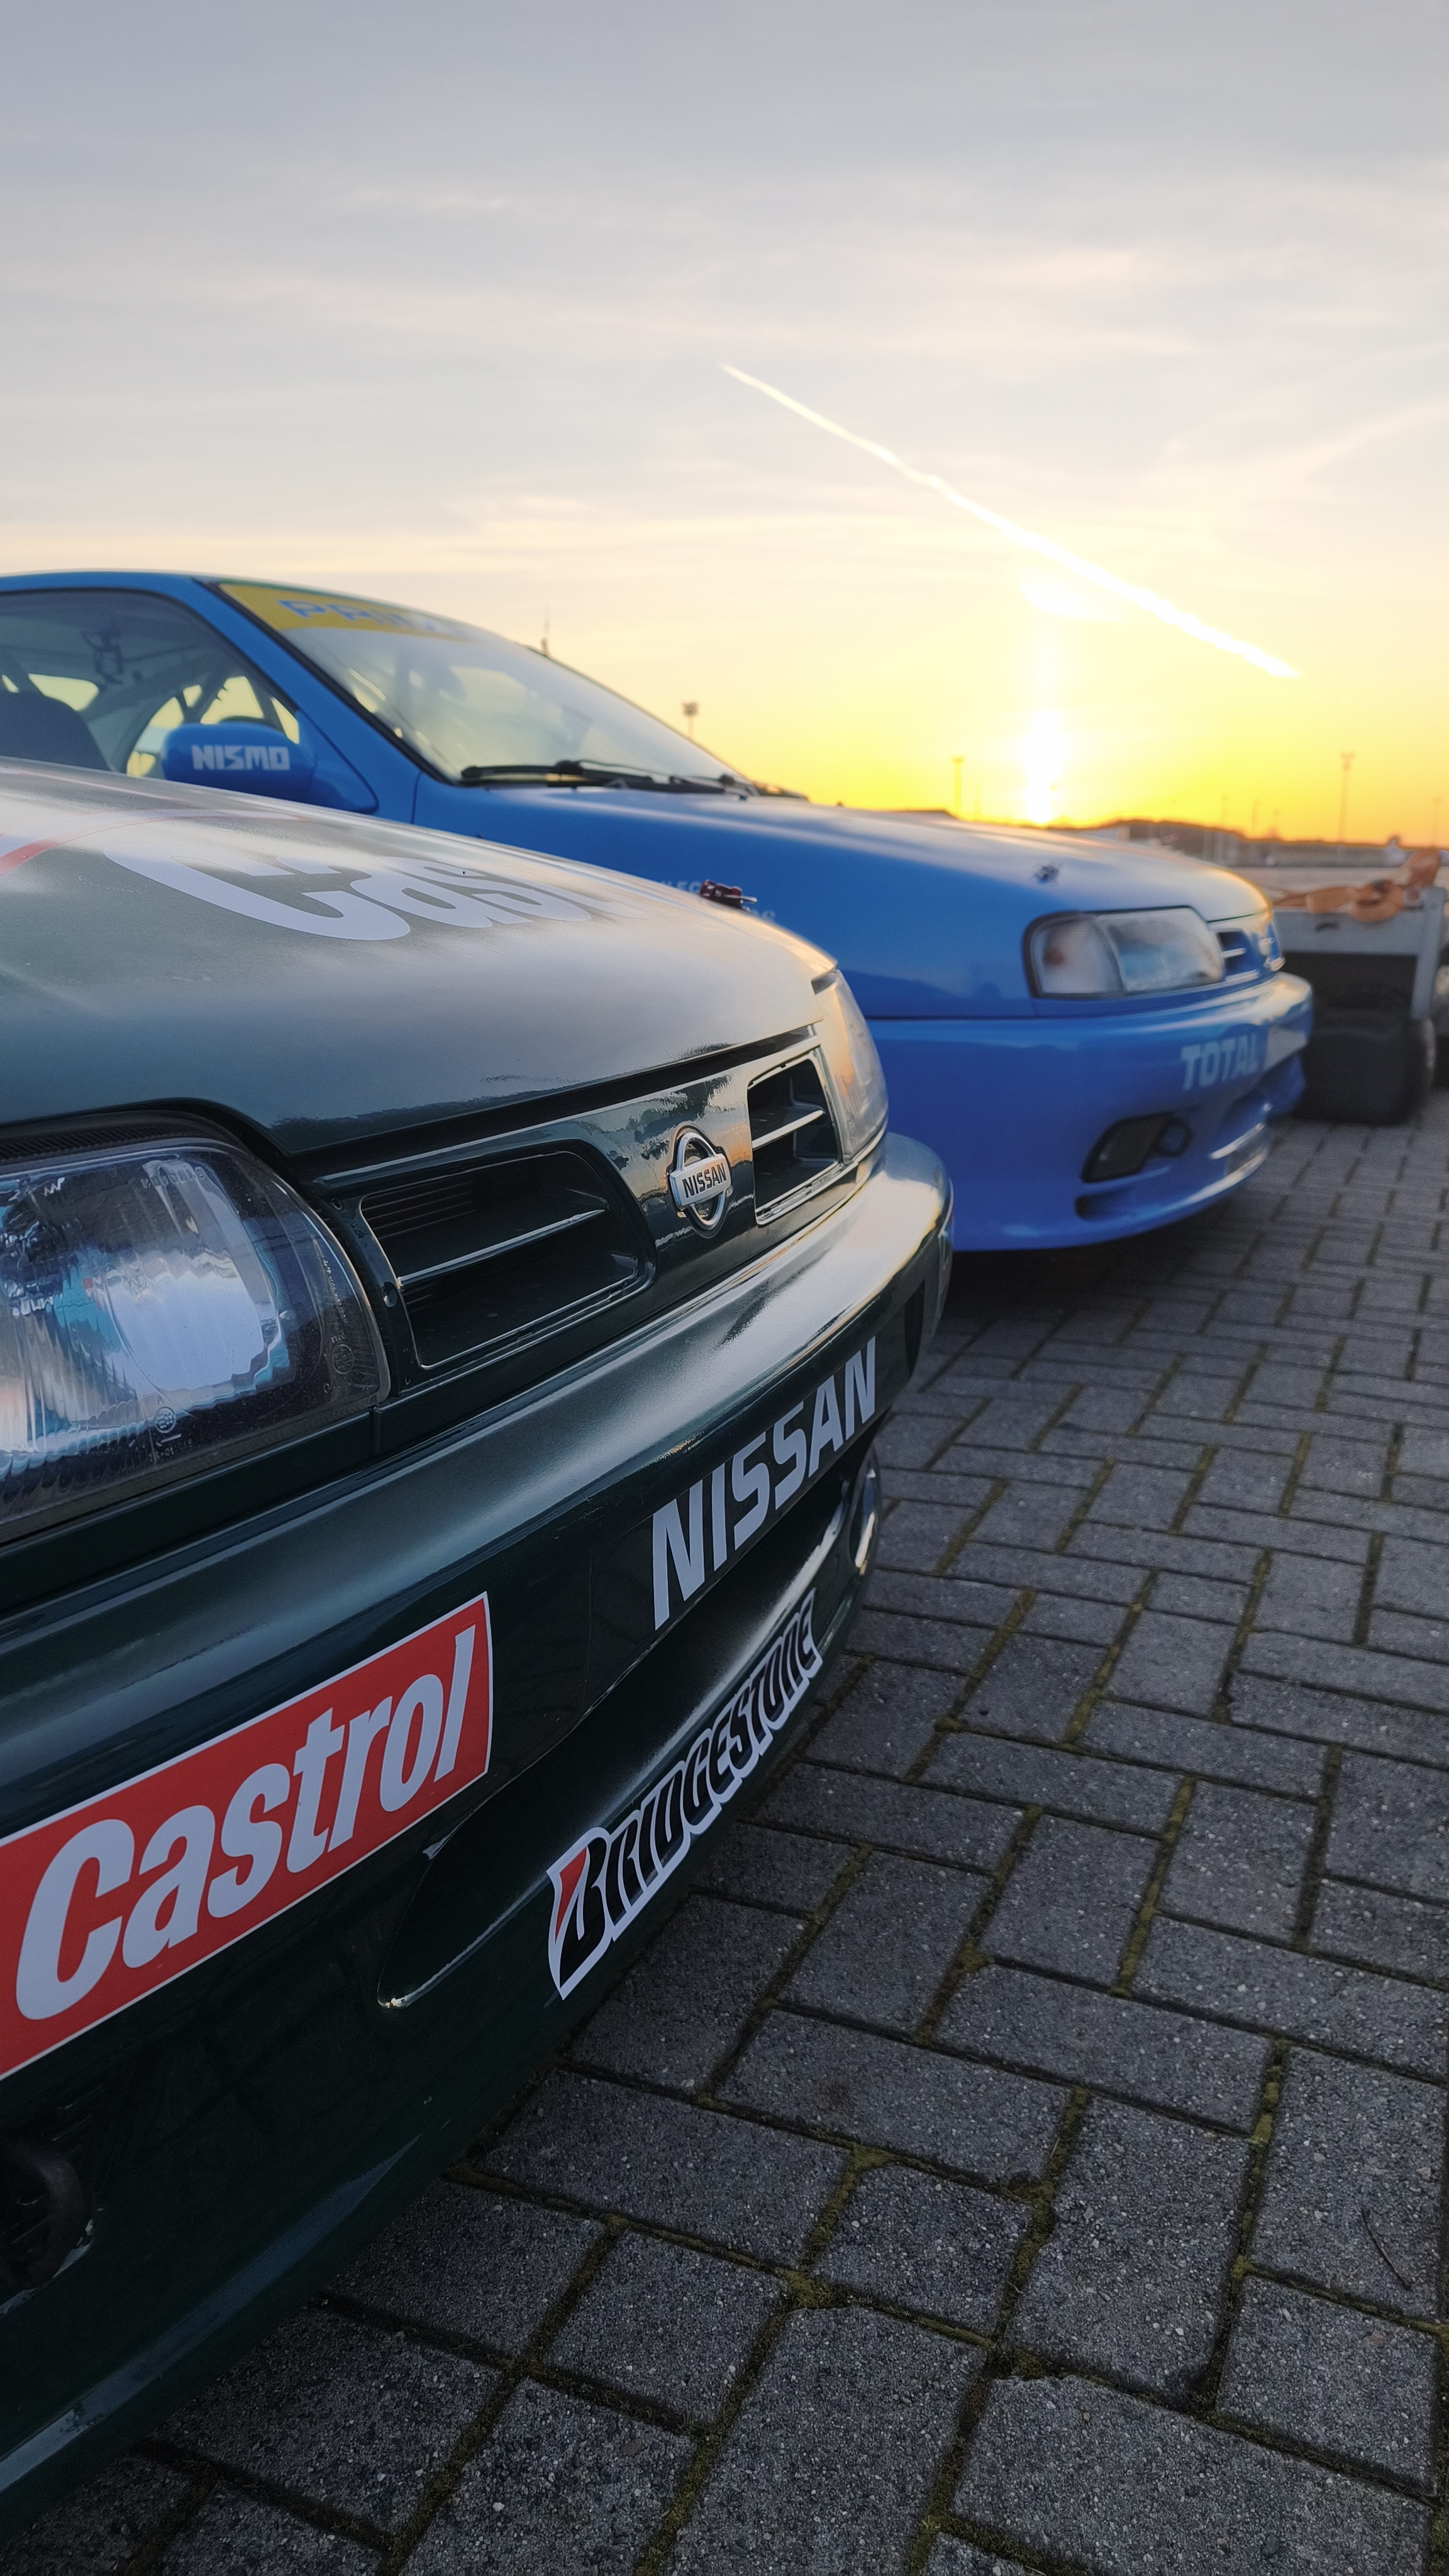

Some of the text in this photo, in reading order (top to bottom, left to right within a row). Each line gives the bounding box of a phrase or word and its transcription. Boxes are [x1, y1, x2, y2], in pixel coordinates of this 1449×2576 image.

[191, 745, 291, 770] NISMO
[1180, 1033, 1258, 1091] TOTAL
[682, 1163, 726, 1198] NISSAN
[653, 1336, 875, 1631] NISSAN
[16, 1624, 477, 2021] Castrol
[551, 1594, 820, 1995] BRIDGESTONE
